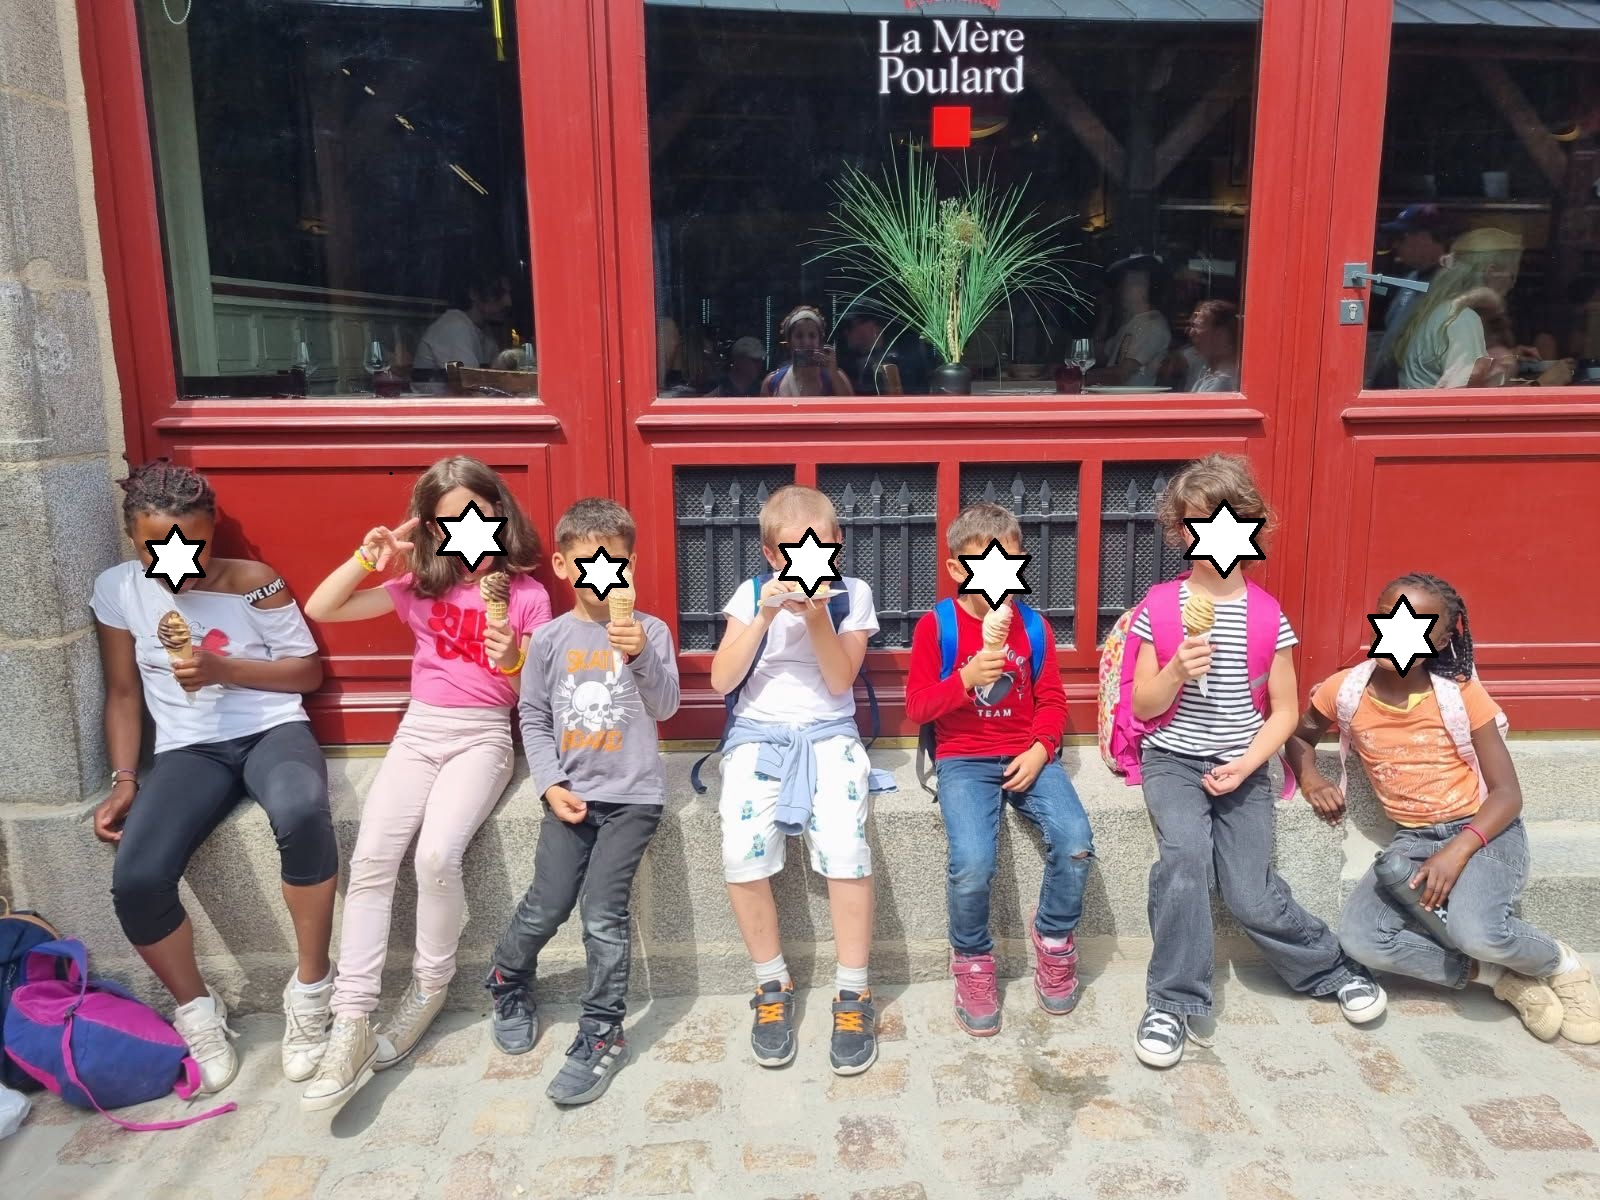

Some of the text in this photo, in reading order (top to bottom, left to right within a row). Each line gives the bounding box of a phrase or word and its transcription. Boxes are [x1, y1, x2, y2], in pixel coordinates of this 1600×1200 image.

[879, 19, 1025, 54] La Mère
[879, 56, 1025, 94] Poulard
[244, 578, 284, 603] OVE LOVE
[978, 708, 1012, 717] TEAM
